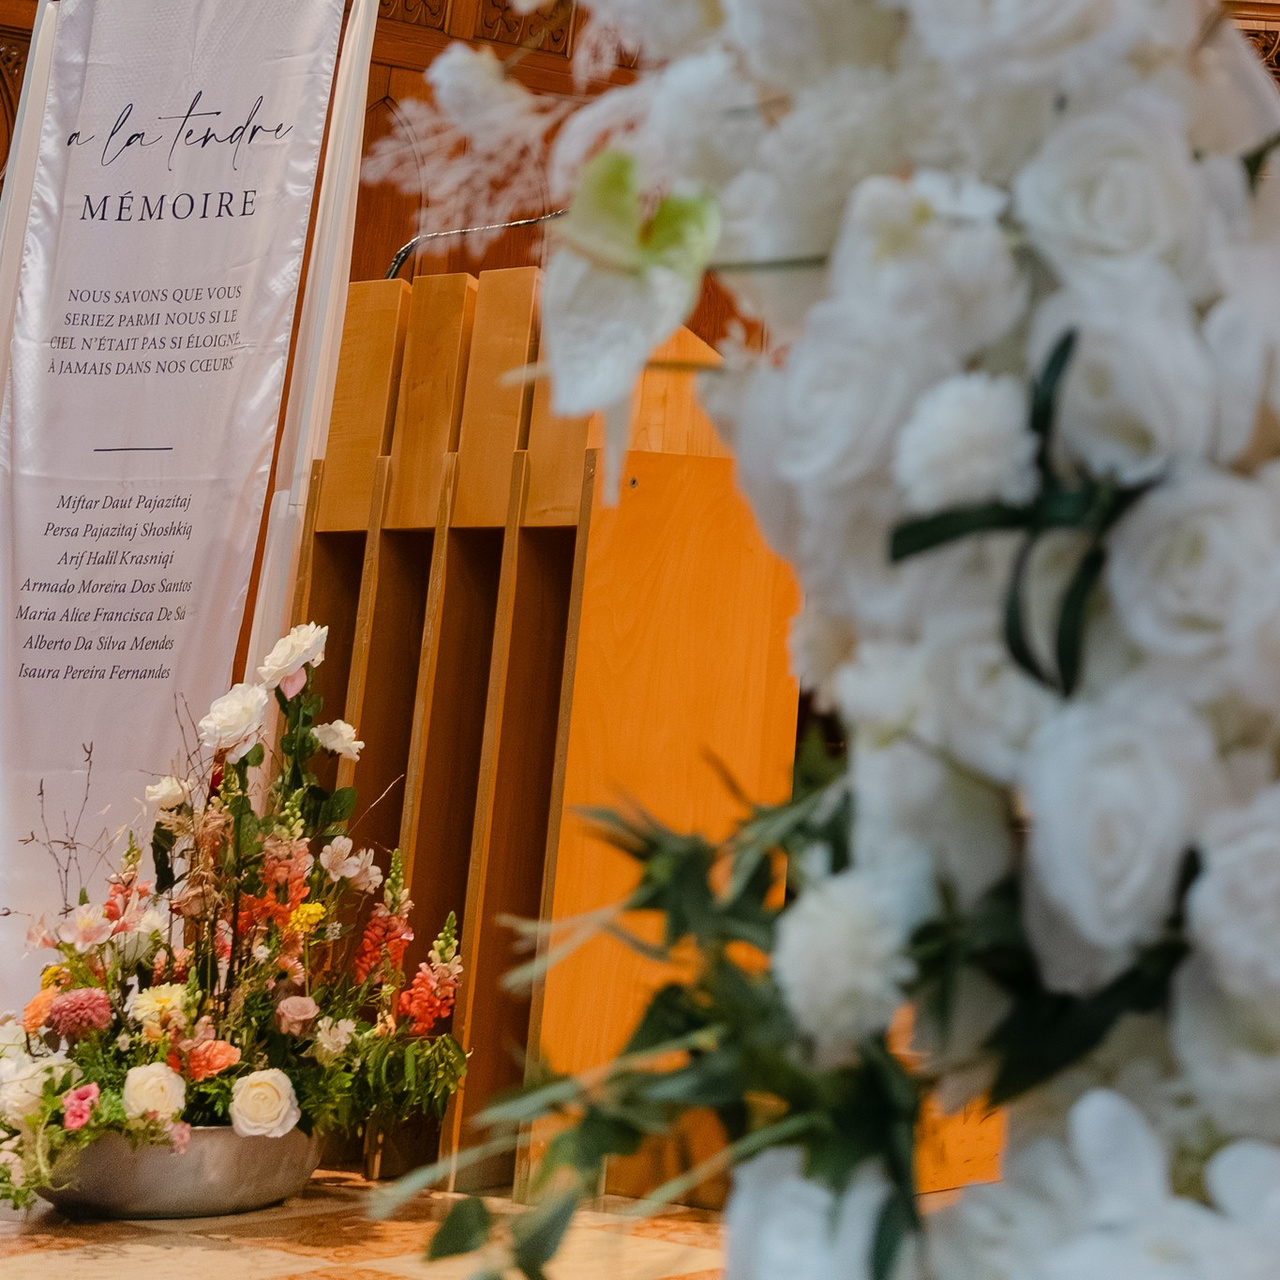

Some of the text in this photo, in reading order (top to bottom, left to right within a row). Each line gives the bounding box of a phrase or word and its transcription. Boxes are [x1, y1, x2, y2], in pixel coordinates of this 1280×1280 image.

[101, 103, 162, 167] la
[158, 90, 293, 172] tendre
[80, 190, 257, 222] MÉMOIRE
[68, 285, 242, 303] NOUS SAVONS QUE VOUS
[64, 308, 238, 327] SERIEZ PARMI NOUS SI LE
[50, 336, 77, 350] CIEL
[141, 336, 166, 350] PAS
[169, 336, 183, 350] SI
[47, 358, 56, 373] À
[58, 360, 112, 376] JAMAIS
[115, 360, 152, 376] DANS
[155, 360, 186, 374] NOS
[56, 494, 192, 514] Miftar Daut Pajazitaj
[44, 522, 80, 538] Persa
[82, 523, 139, 542] Pajazitaj
[57, 550, 175, 570] Arif Halil Krasniqi
[20, 578, 193, 594] Armado Moreira Dos Santos
[15, 605, 57, 622] Maria
[59, 607, 91, 622] Alice
[93, 607, 154, 622] Francisca
[157, 606, 173, 622] De
[23, 634, 175, 651] Alberto Da Silva Mendes
[18, 663, 171, 679] Isaura Pereira Fernandes
